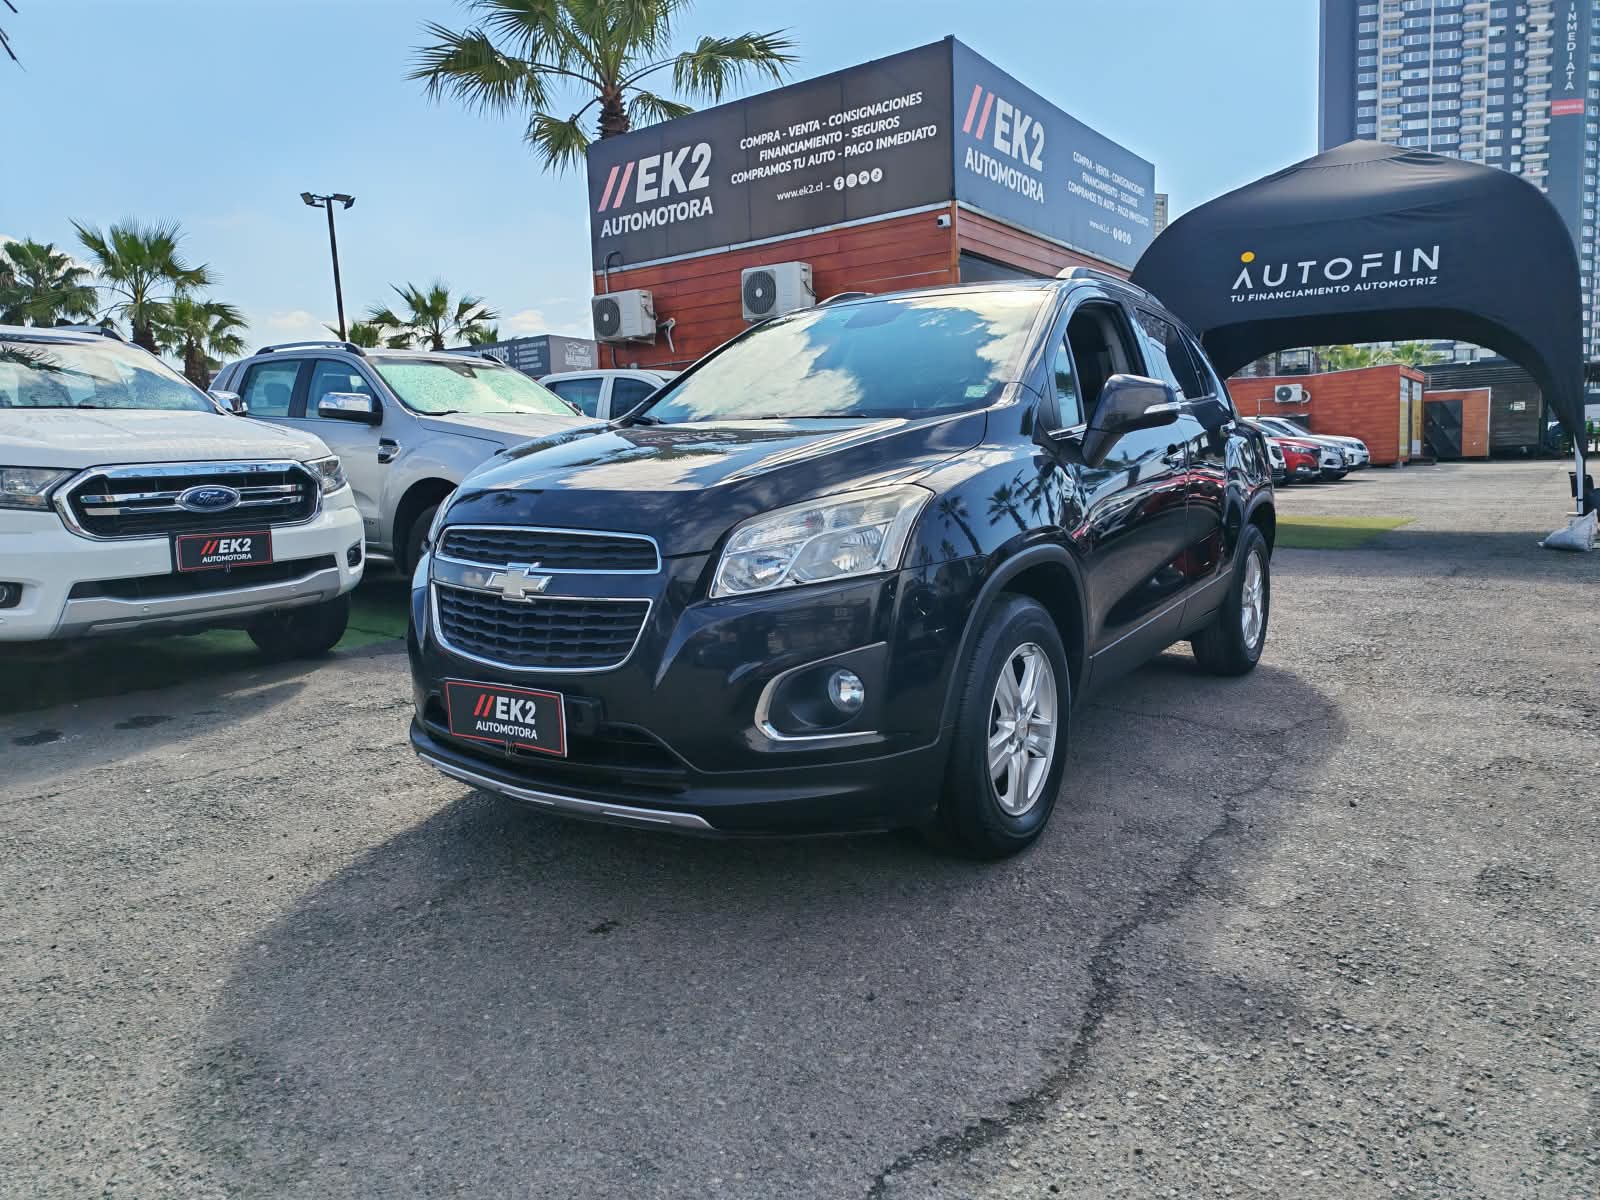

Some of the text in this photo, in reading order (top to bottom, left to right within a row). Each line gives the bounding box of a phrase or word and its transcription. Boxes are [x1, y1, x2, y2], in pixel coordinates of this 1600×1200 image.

[1564, 2, 1578, 91] INMEDIATA
[740, 130, 781, 150] COMPRA
[788, 120, 820, 138] VENTA
[828, 92, 923, 127] CONSIGNACIONES
[759, 130, 842, 162] FINANCIAMIENTO
[851, 116, 900, 139] SEGUROS
[731, 161, 791, 185] COMPRAMOS
[793, 157, 806, 170] TU
[807, 150, 836, 167] AUTO
[844, 140, 873, 158] PAGO
[876, 125, 937, 151] INMEDIATO
[965, 147, 1044, 204] AUTOMOTORA
[1073, 151, 1093, 170] COMPRA
[777, 181, 823, 201] www.ek2.cl
[601, 196, 713, 238] AUTOMOTORA
[1232, 245, 1440, 290] AUTOFIN
[1230, 276, 1438, 303] TU FINANCIAMIENTO AUTOMOTRIZ
[197, 491, 227, 505] Ford
[202, 553, 252, 564] AUTOMOTORA
[476, 720, 538, 740] AUTOMOTORA
